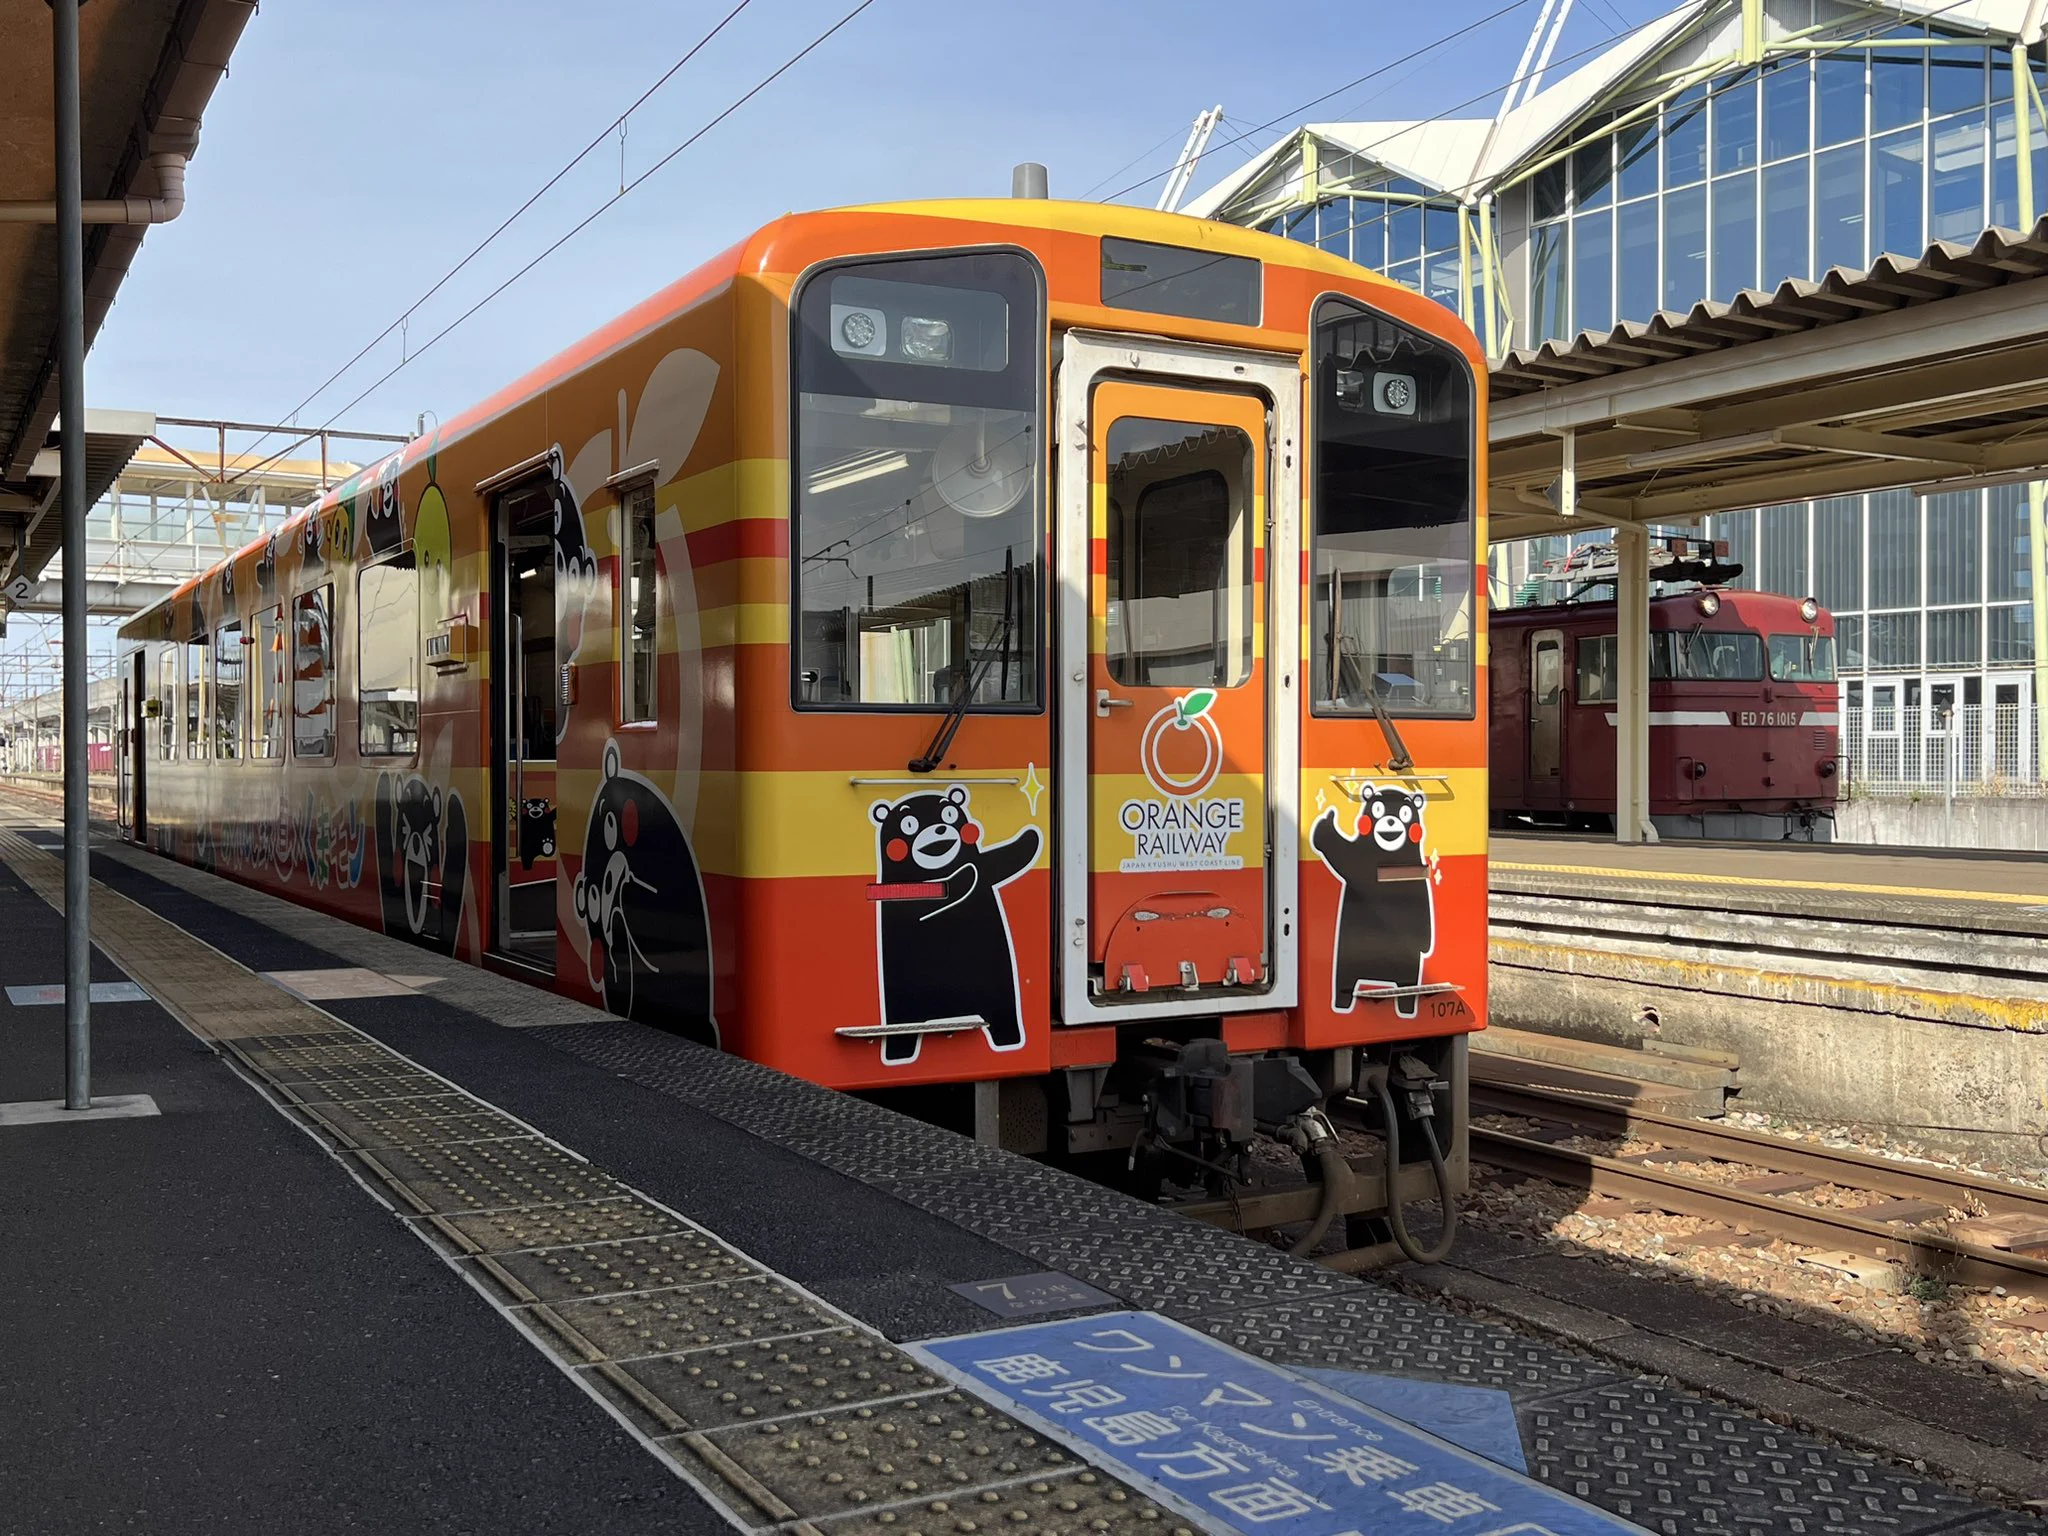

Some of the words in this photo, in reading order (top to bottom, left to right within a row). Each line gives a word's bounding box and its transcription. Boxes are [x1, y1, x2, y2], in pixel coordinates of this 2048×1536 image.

[15, 582, 29, 599] 2
[1740, 711, 1757, 726] ED
[1760, 711, 1774, 726] 76
[1776, 711, 1797, 726] 1015
[1121, 801, 1241, 831] ORANGE
[1138, 831, 1227, 855] RAILWAY
[1122, 862, 1146, 870] JAPAN
[1147, 861, 1178, 869] KYUSHU
[1179, 860, 1198, 868] WEST
[1224, 859, 1241, 867] LINE
[1430, 1001, 1466, 1018] 107A
[1293, 1400, 1383, 1441] Entrance
[973, 1352, 1363, 1536] 鹿児島方面
[1161, 1405, 1198, 1422] For
[1194, 1422, 1299, 1478] Kagoshima
